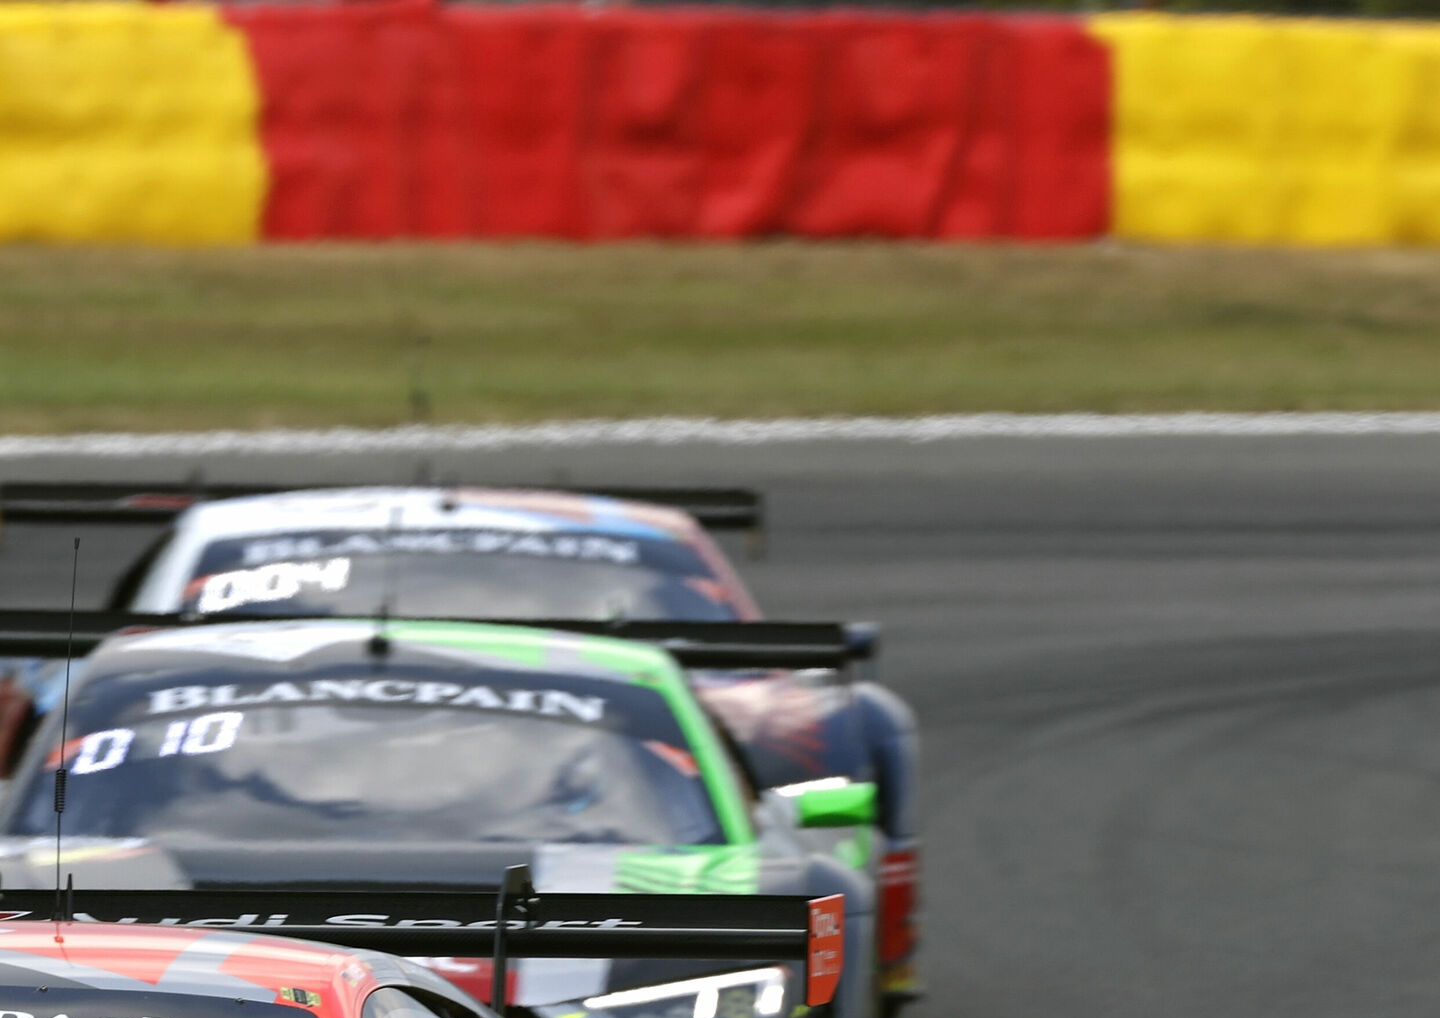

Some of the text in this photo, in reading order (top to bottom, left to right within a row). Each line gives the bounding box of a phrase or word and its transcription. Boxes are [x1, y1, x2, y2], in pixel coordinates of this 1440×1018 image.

[243, 530, 639, 565] BLANCPAIN
[148, 679, 605, 722] BLANCPAIN
[47, 912, 289, 927] di
